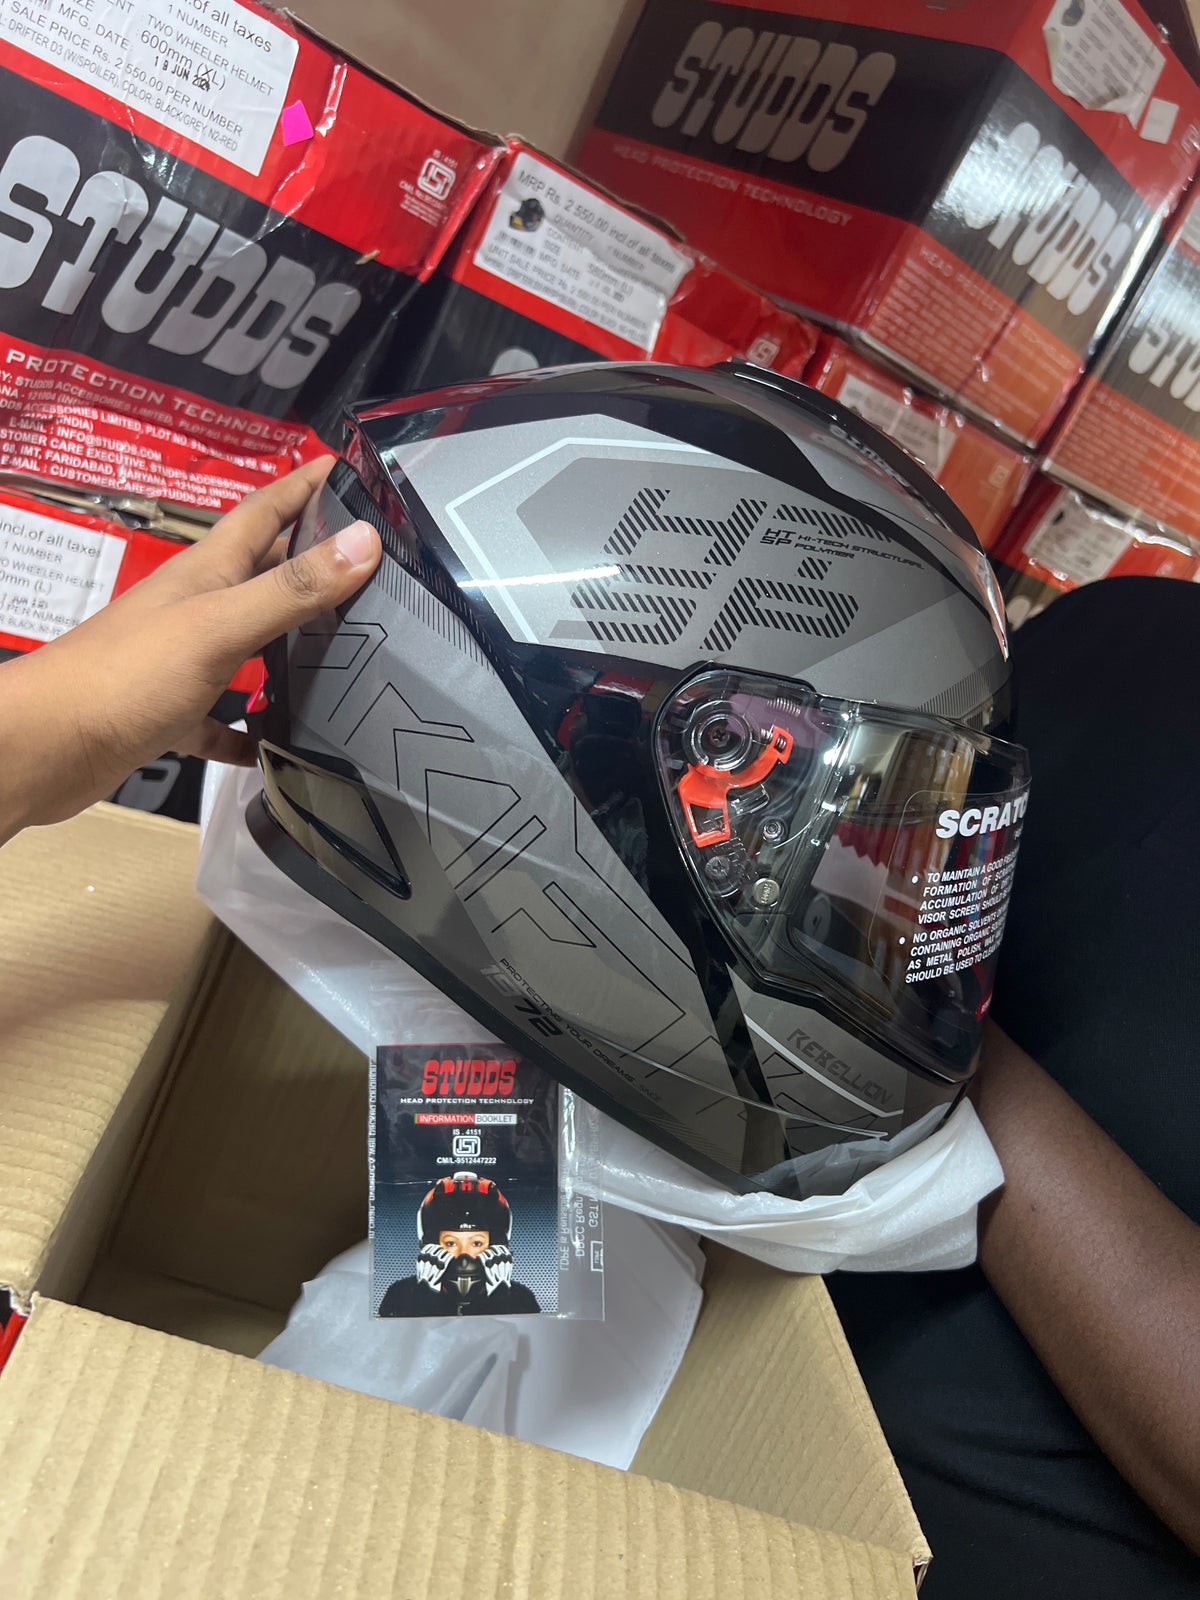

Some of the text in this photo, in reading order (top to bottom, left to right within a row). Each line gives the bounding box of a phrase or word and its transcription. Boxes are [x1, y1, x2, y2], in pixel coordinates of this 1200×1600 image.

[58, 3, 91, 31] MFG.
[171, 63, 190, 81] JUN
[175, 9, 229, 48] NUMBER
[211, 9, 272, 53] all taxes
[140, 29, 193, 69] 600mm
[147, 13, 275, 97] TWO WHEELER HELMET
[8, 17, 50, 49] DRIFTER
[49, 40, 65, 57] D3
[208, 128, 239, 152] N2-RED
[11, 0, 244, 138] SALE PRICE Rs. 2 550.00 PER NUMBER
[652, 20, 896, 173] STUDDS
[517, 169, 546, 193] MRP
[545, 186, 562, 207] Rs.
[564, 199, 573, 213] 2
[653, 155, 740, 193] PROTECTION
[742, 182, 853, 227] TECHNOLOGY
[0, 134, 362, 390] STUDDS
[6, 348, 308, 446] PROTECTION TECHNOLOGY
[15, 375, 54, 391] STUDDS
[23, 401, 99, 421] ACCESSORIES
[100, 412, 143, 435] LIMITED,
[145, 424, 172, 441] PLOT
[9, 416, 163, 462] E-MAIL INFO@STUDDS.COM
[49, 437, 85, 456] CARE
[86, 446, 149, 471] EXECUTIVE,
[20, 445, 43, 460] IMT,
[45, 450, 117, 477] FARIDABAD,
[0, 454, 222, 509] E-MAIL CUSTOMERCARE@STUDDS.COM
[12, 542, 63, 564] NUMBER
[46, 535, 64, 547] all
[759, 535, 856, 560] SP POLYMER
[763, 527, 926, 570] HT HI-TECH STRUCTURAL
[12, 560, 64, 582] WHEELER
[922, 873, 993, 898] FORMATION OF
[927, 857, 1005, 884] TO MAINTAIN A GOOD
[918, 910, 947, 925] VISOR
[948, 902, 980, 920] SCREEN
[919, 882, 1000, 911] ACCUMULATION OF
[910, 925, 991, 957] CONTAINING ORGANIC
[912, 912, 997, 944] NO ORGANIC SOLVENTS
[905, 967, 943, 984] SHOULD
[943, 962, 955, 976] BE
[955, 955, 974, 971] USED
[974, 952, 982, 963] TO
[906, 958, 922, 971] AS
[925, 951, 954, 967] METAL
[500, 957, 564, 1023] PROTECTING
[566, 1023, 593, 1049] YOUR
[593, 1048, 637, 1084] DREAMS
[421, 1059, 517, 1096] STUDDS
[420, 1114, 513, 1123] INFORMATION BOOKLET
[478, 1097, 535, 1105] TECHNOLOGY
[452, 1128, 482, 1136] IS 4151
